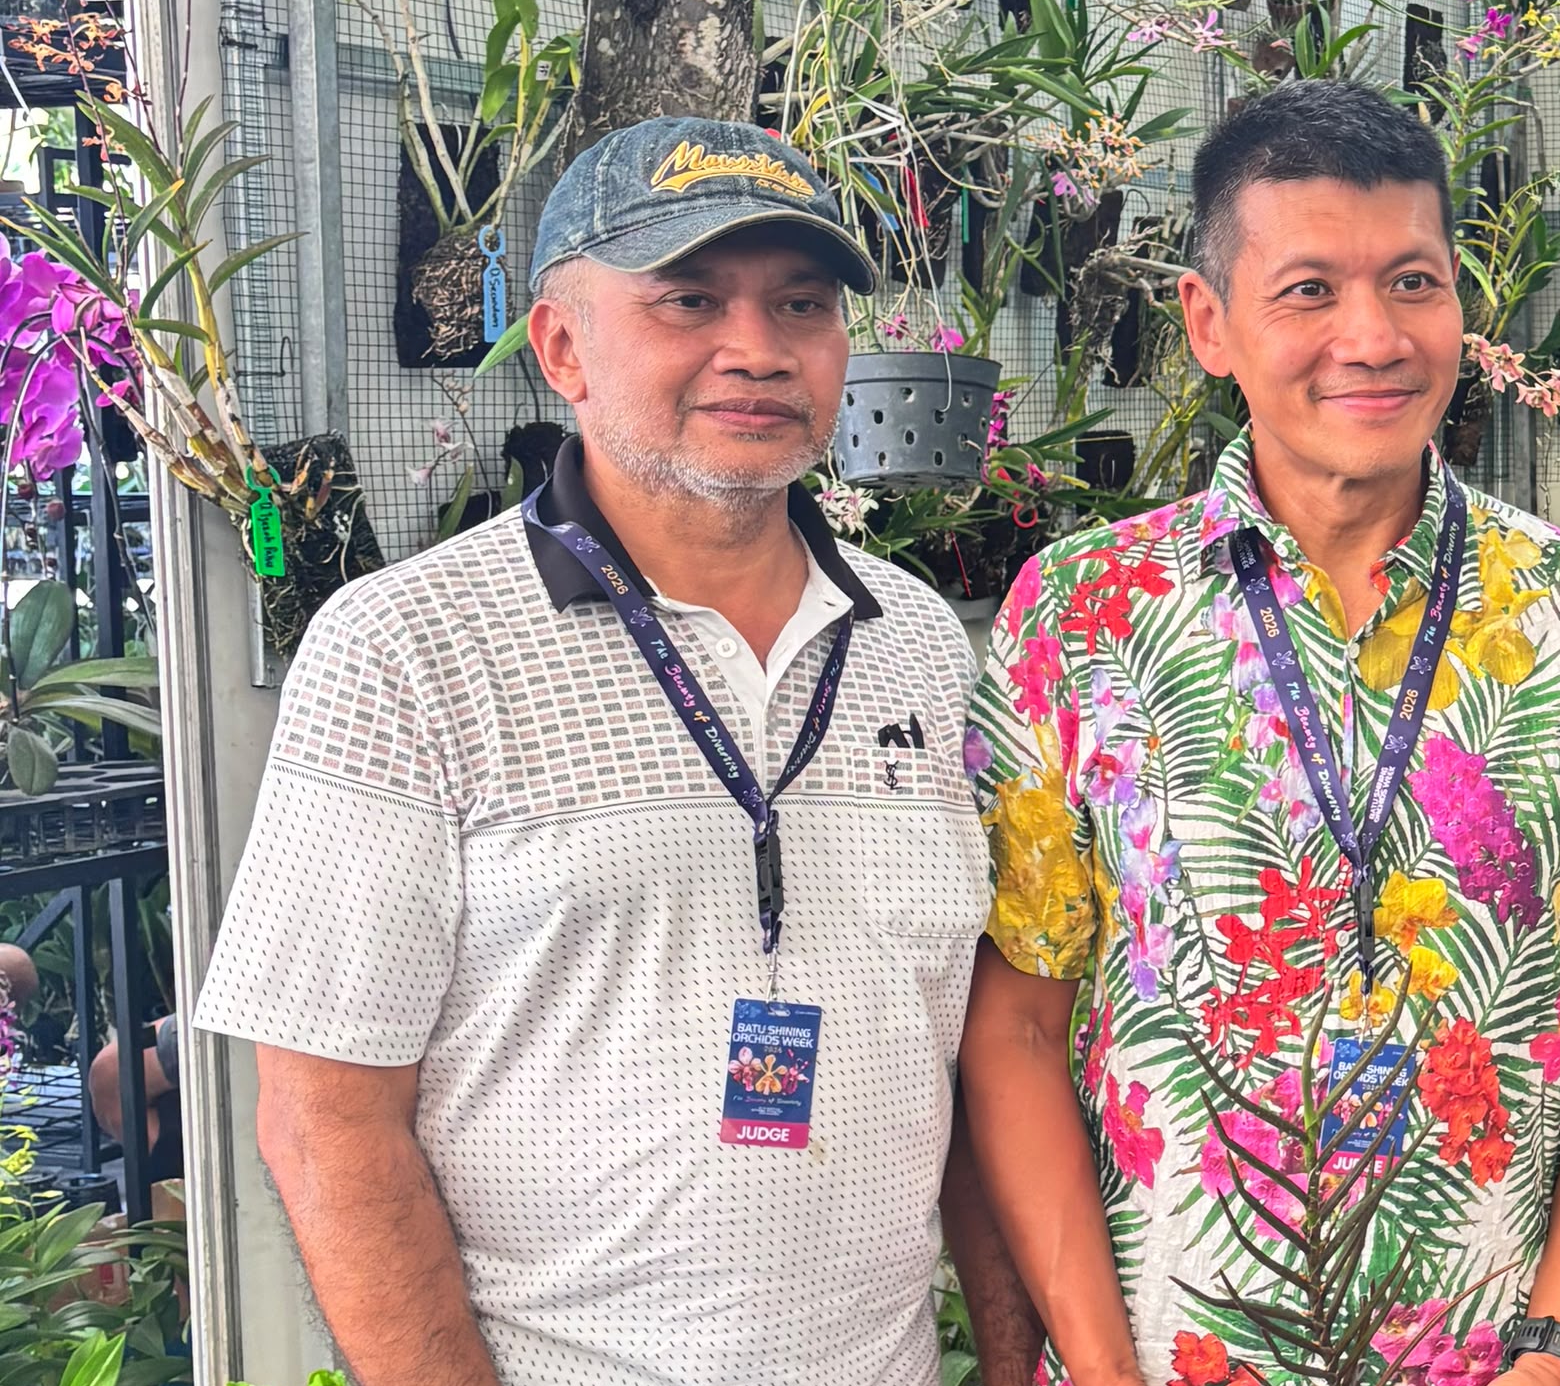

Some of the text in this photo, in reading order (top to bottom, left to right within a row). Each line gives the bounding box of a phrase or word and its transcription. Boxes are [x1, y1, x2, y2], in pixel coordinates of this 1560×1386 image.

[600, 564, 630, 596] 2026
[1424, 521, 1460, 645] The Beauty of Diversity
[1260, 607, 1279, 638] 2026
[651, 639, 740, 781] The Beauty of Diversity
[1400, 689, 1419, 721] 2026
[1286, 682, 1342, 822] The Beauty of Diversity
[732, 1032, 814, 1048] ORCHIDS WEEK
[736, 1022, 812, 1038] BATU SHINING
[736, 1125, 790, 1142] JUDGE
[1332, 1156, 1384, 1174] JUDE
